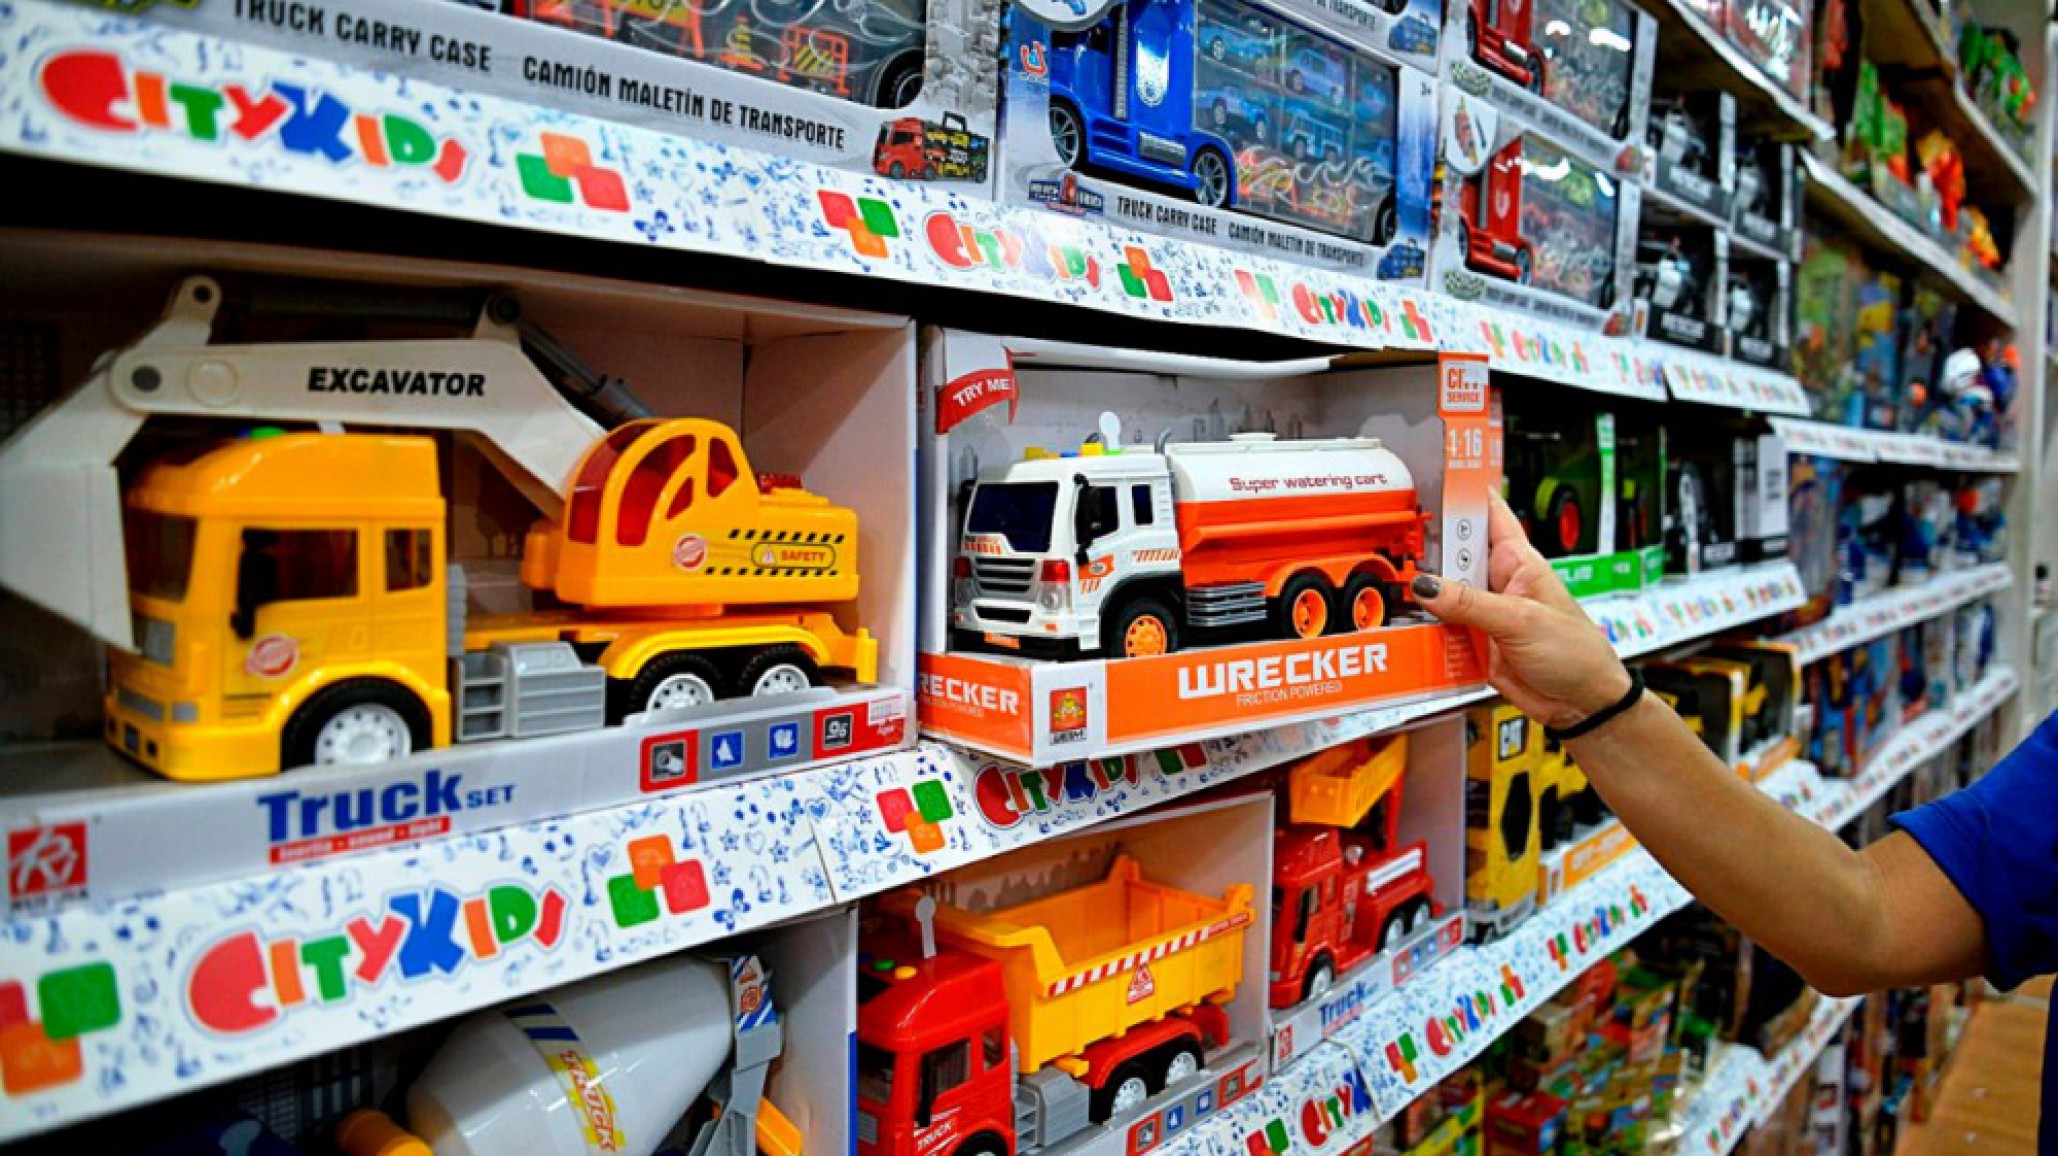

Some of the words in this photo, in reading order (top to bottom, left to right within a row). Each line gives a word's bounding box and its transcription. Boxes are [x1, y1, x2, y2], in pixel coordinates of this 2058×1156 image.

[233, 0, 325, 34] TRUCK
[336, 13, 421, 57] CARRY
[429, 38, 491, 72] CASE
[523, 56, 611, 97] CAMIÓN
[619, 77, 704, 119] MALETÍN
[711, 99, 733, 125] DE
[740, 104, 845, 149] TRANSPORTE
[1117, 195, 1153, 220] TRUCK
[1156, 204, 1190, 228] CARRY
[1192, 213, 1218, 235] CASE
[308, 367, 486, 396] EXCAVATOR
[952, 381, 984, 407] TRY
[986, 378, 1012, 393] ME
[1447, 428, 1483, 458] 1:16
[1229, 476, 1279, 493] Super
[1283, 473, 1353, 489] watering
[1355, 473, 1388, 486] cart
[780, 551, 827, 562] SAFETY
[1178, 643, 1388, 699] WRECKER
[920, 672, 1019, 715] RECKER
[1237, 688, 1288, 707] FRICTION
[1290, 683, 1343, 700] POWERED
[257, 769, 463, 842] Truck
[466, 784, 516, 809] SET
